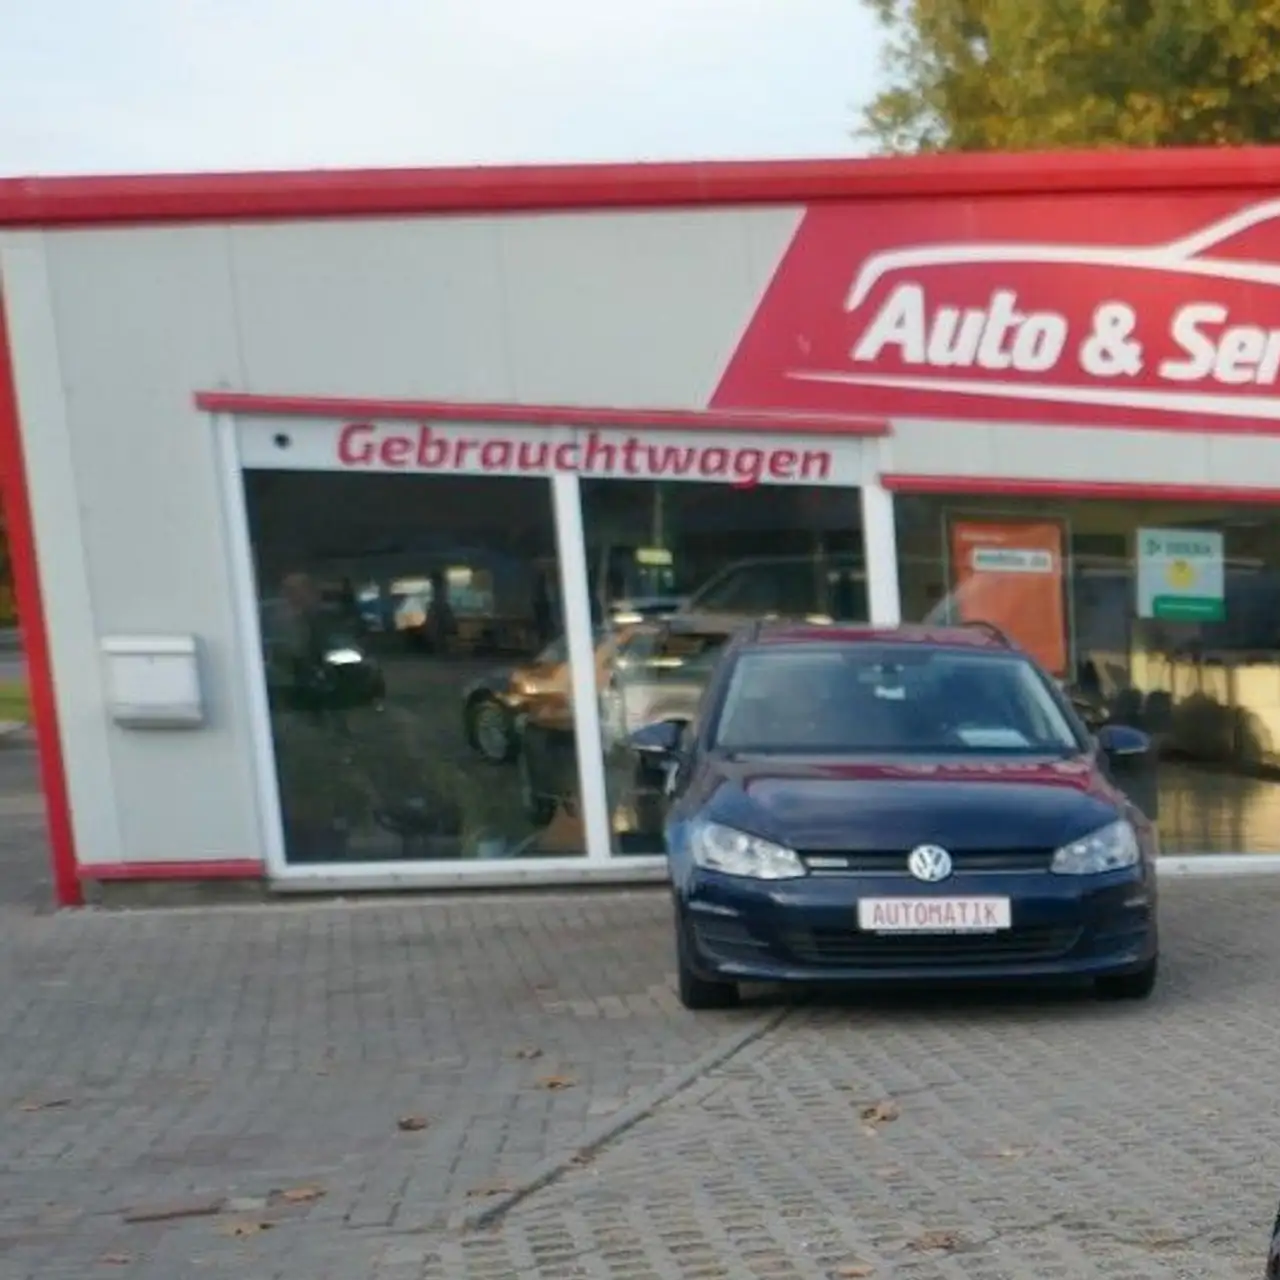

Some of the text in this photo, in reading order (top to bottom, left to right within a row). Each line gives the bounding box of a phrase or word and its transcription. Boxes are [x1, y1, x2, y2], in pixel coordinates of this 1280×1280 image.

[852, 284, 1067, 374] Auto
[1080, 303, 1144, 379] &
[336, 420, 834, 490] Gebrauchtwagen
[873, 902, 998, 925] AUTOMATIK
